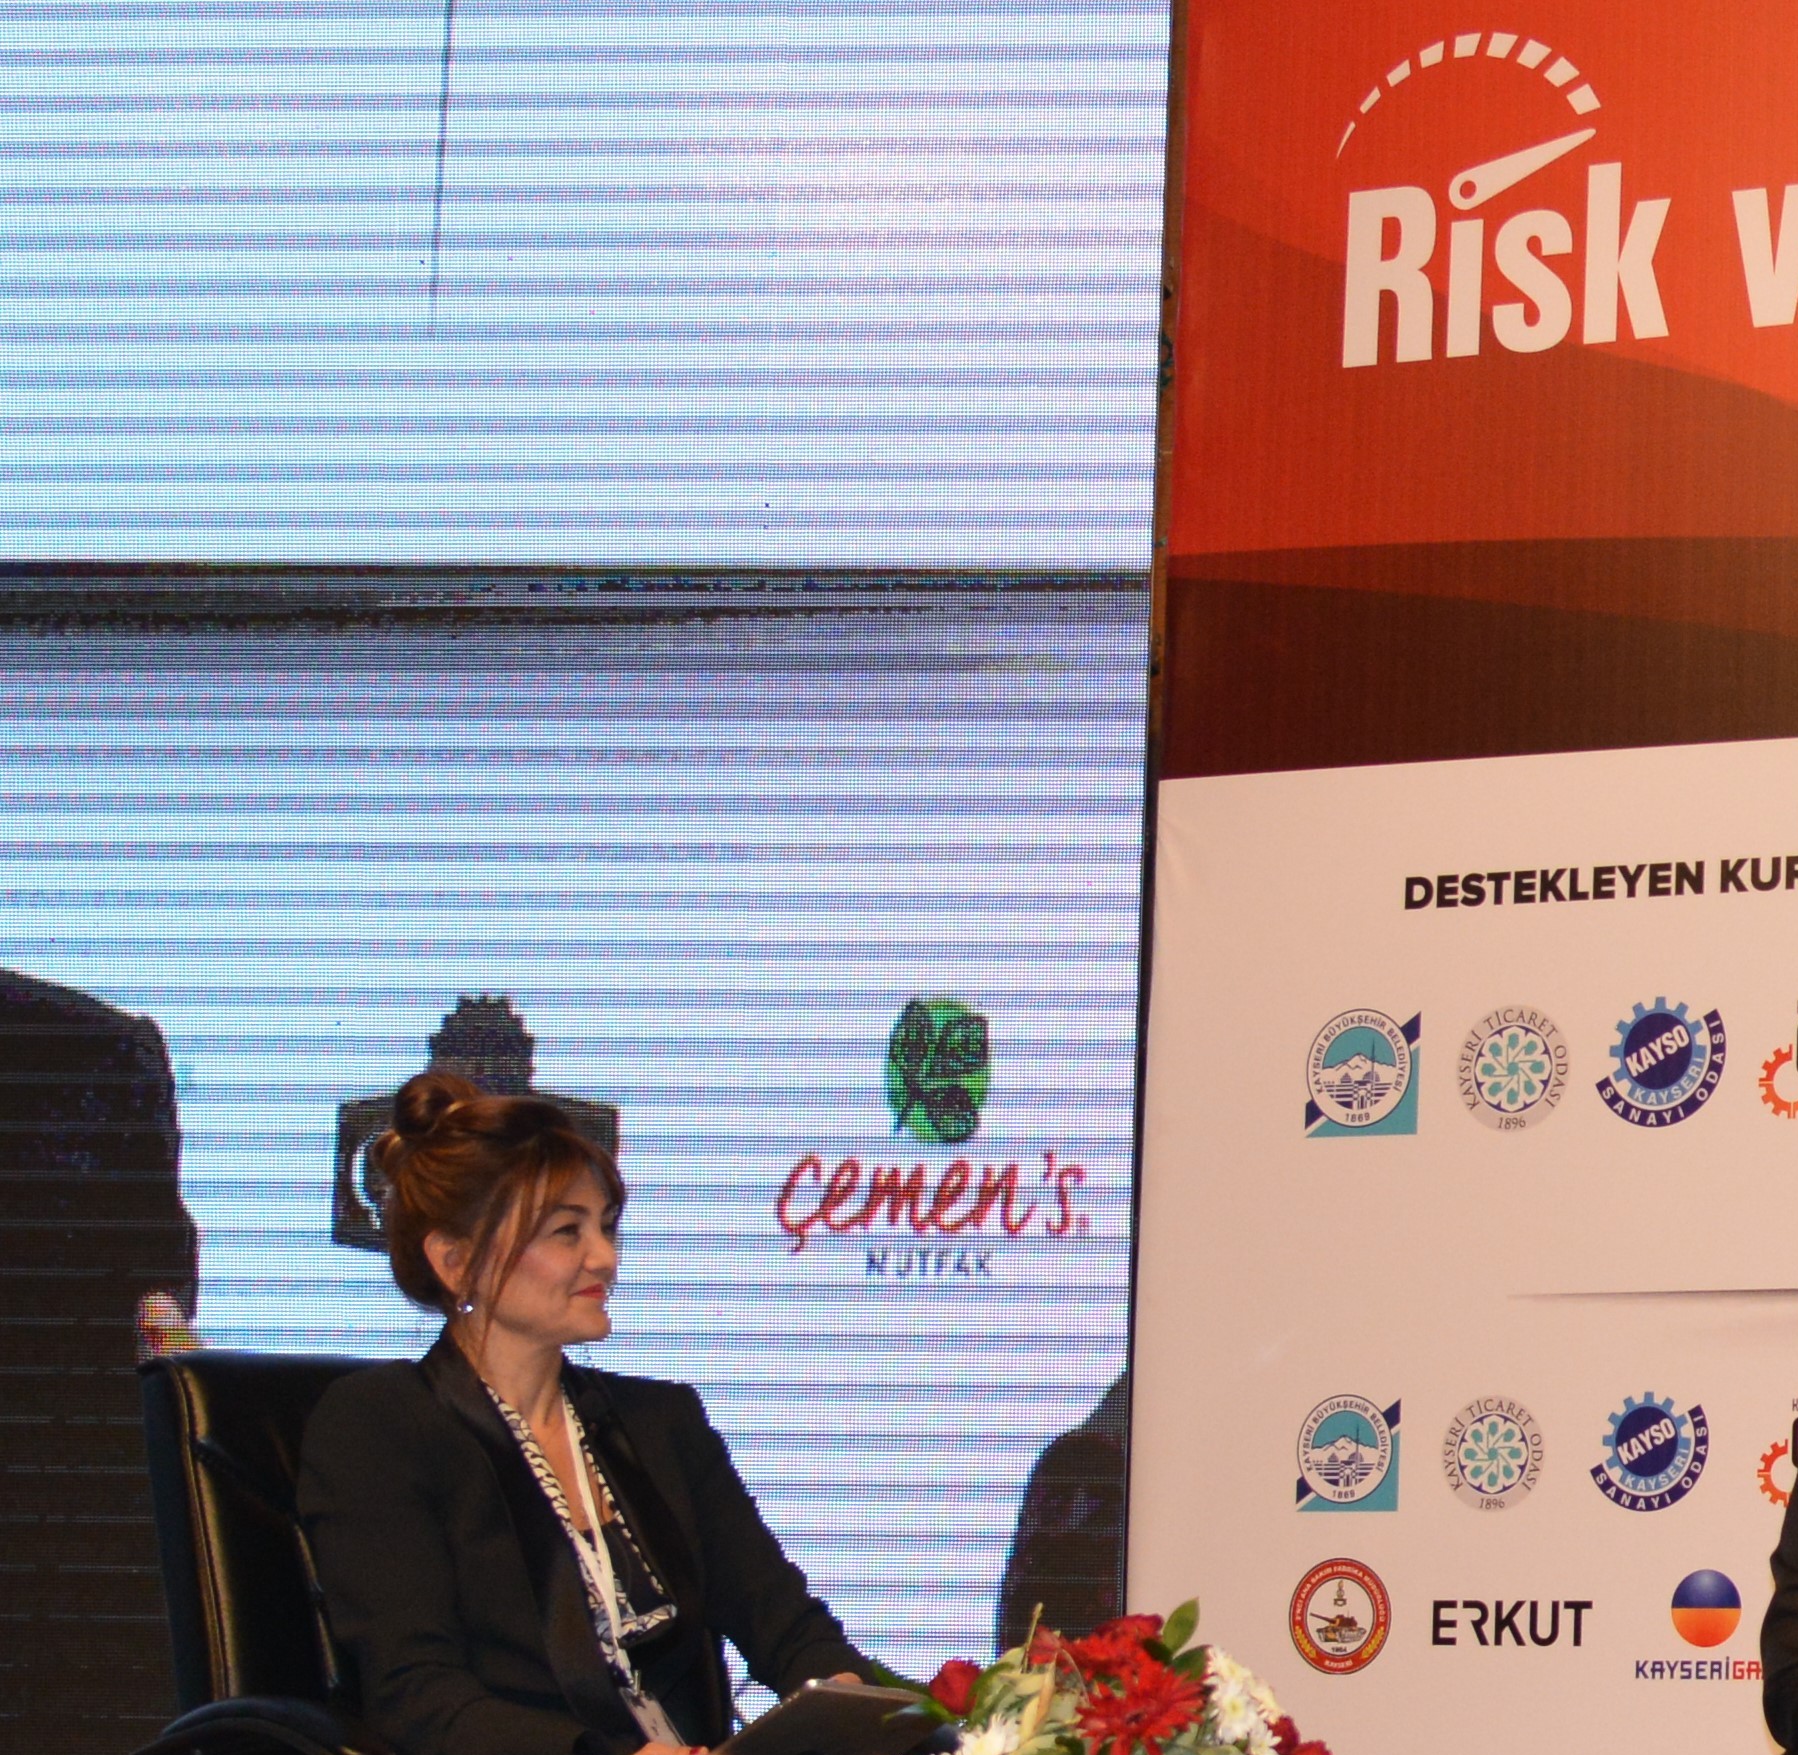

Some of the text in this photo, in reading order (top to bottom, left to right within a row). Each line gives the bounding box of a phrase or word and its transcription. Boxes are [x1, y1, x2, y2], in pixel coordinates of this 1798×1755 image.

[1343, 160, 1671, 368] Risk
[1404, 859, 1706, 910] DESTEKLEYEN
[1546, 1045, 1568, 1108] ODASI
[1625, 1024, 1690, 1078] KAYSO
[1696, 1019, 1725, 1101] ODASI
[1344, 1112, 1371, 1123] 1869
[1497, 1117, 1526, 1130] 1896
[1522, 1433, 1543, 1491] ODASI
[1617, 1418, 1676, 1465] KAYSO
[1682, 1414, 1708, 1488] ODASI
[1479, 1498, 1505, 1509] 1896
[1432, 1600, 1593, 1646] ERKUT
[1635, 1657, 1763, 1680] KAYSERİGA
